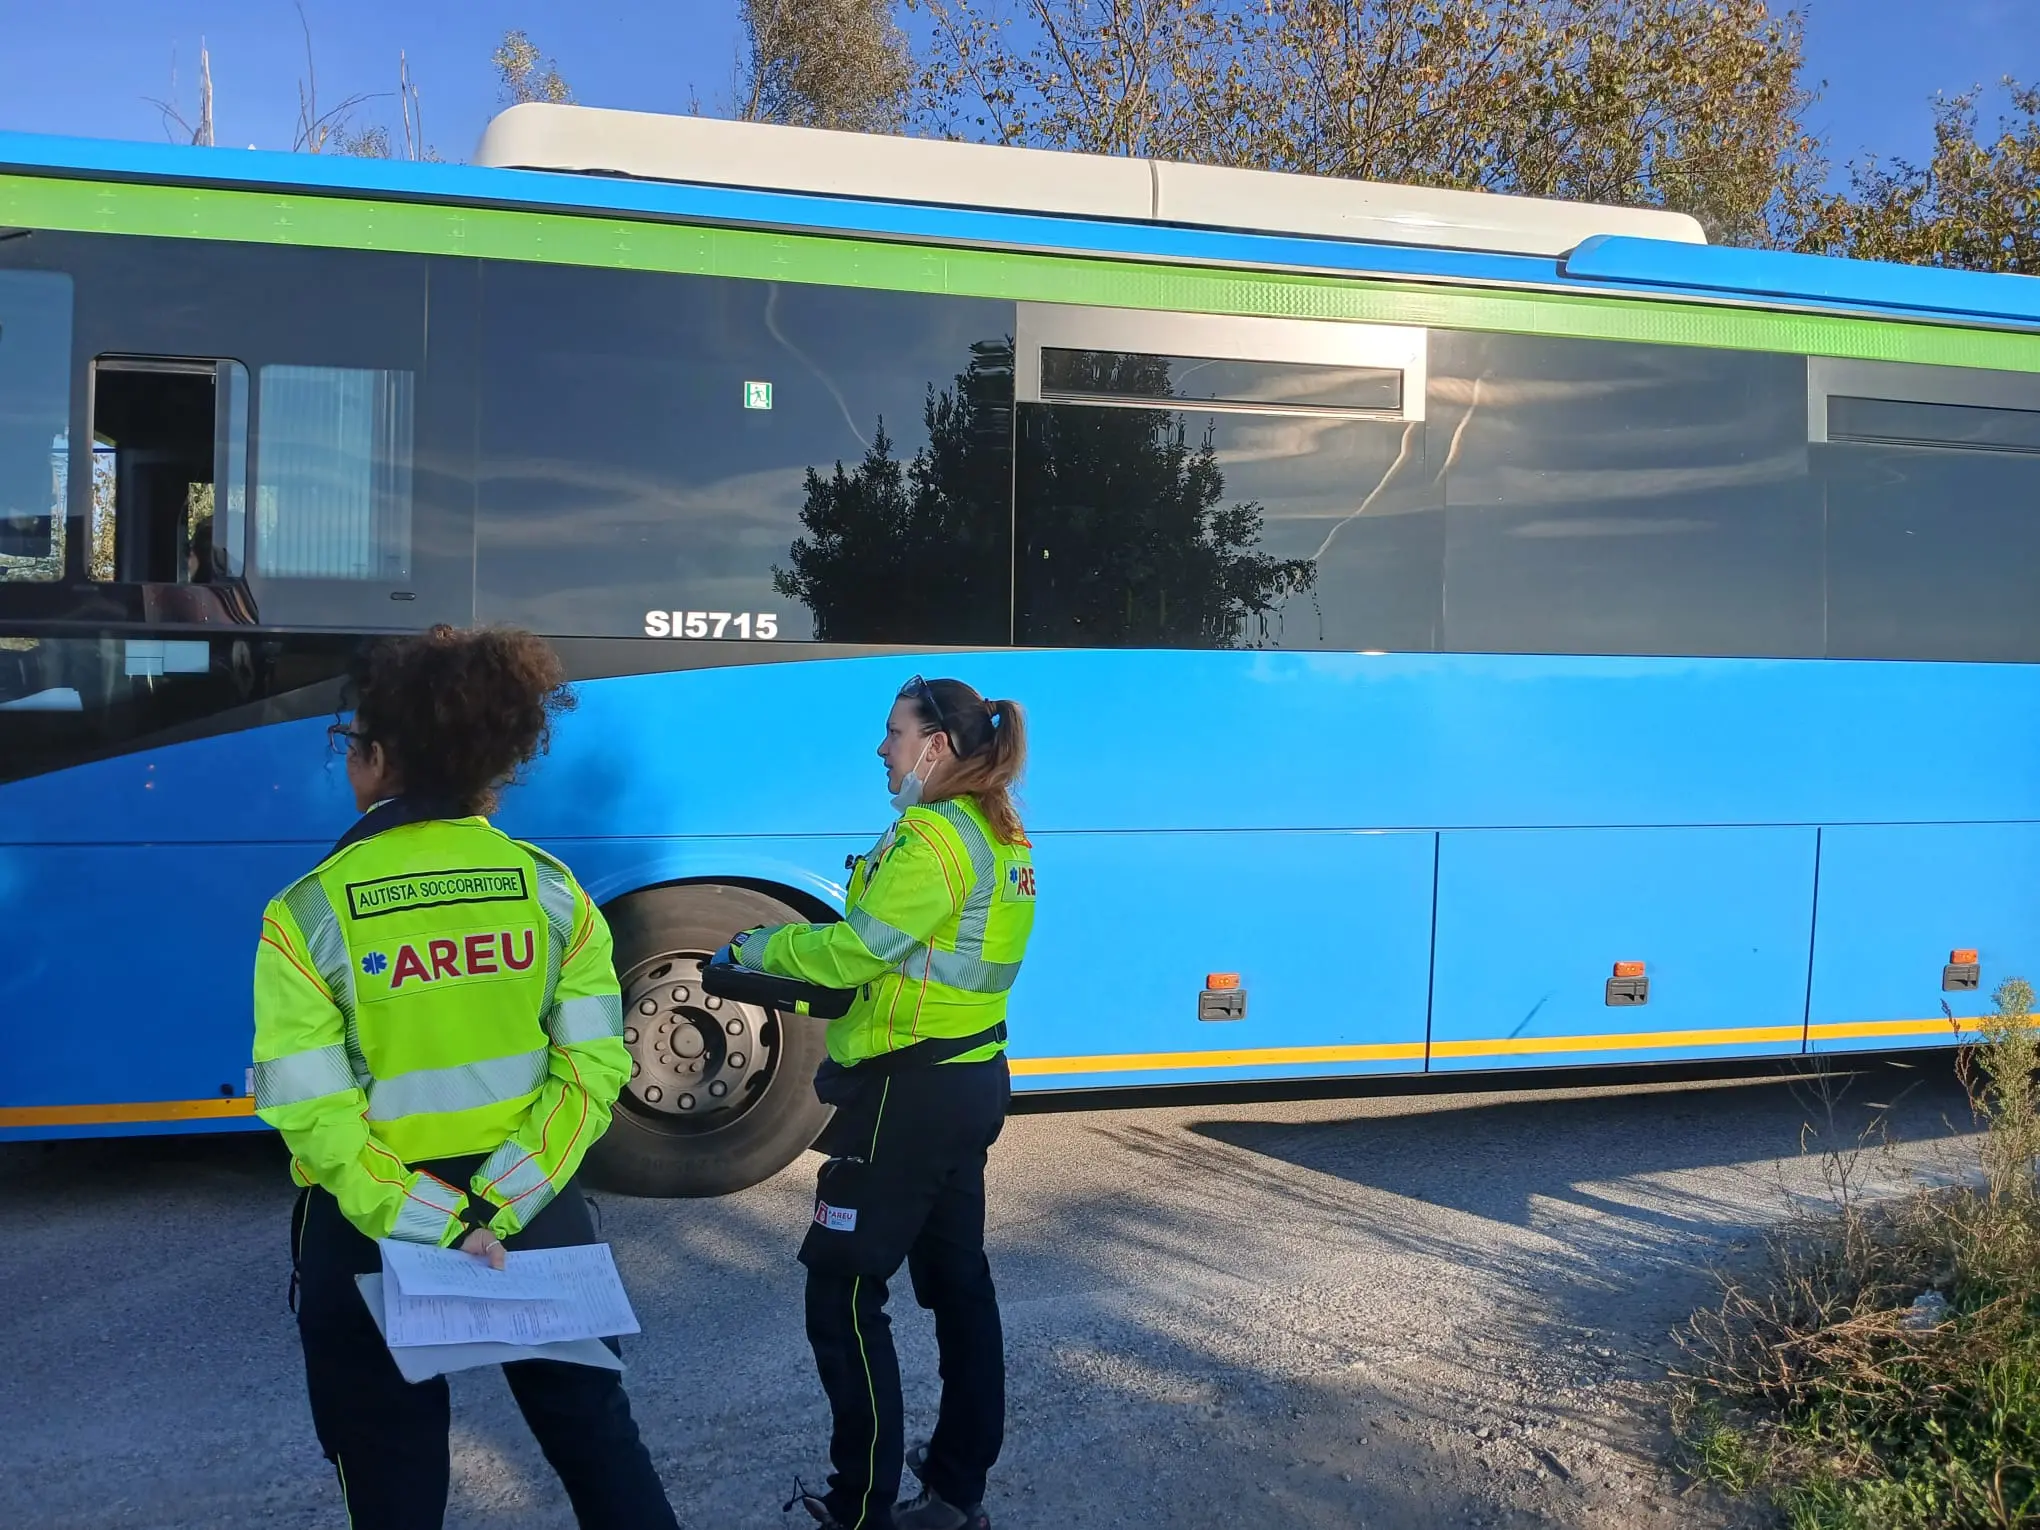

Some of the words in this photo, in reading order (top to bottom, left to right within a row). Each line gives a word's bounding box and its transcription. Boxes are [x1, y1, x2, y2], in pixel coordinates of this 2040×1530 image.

[645, 610, 778, 639] SI5715
[359, 884, 418, 908] AUTISTA
[421, 876, 519, 898] SOCCORRITORE
[1016, 867, 1036, 896] ARE
[390, 930, 536, 989] AREU
